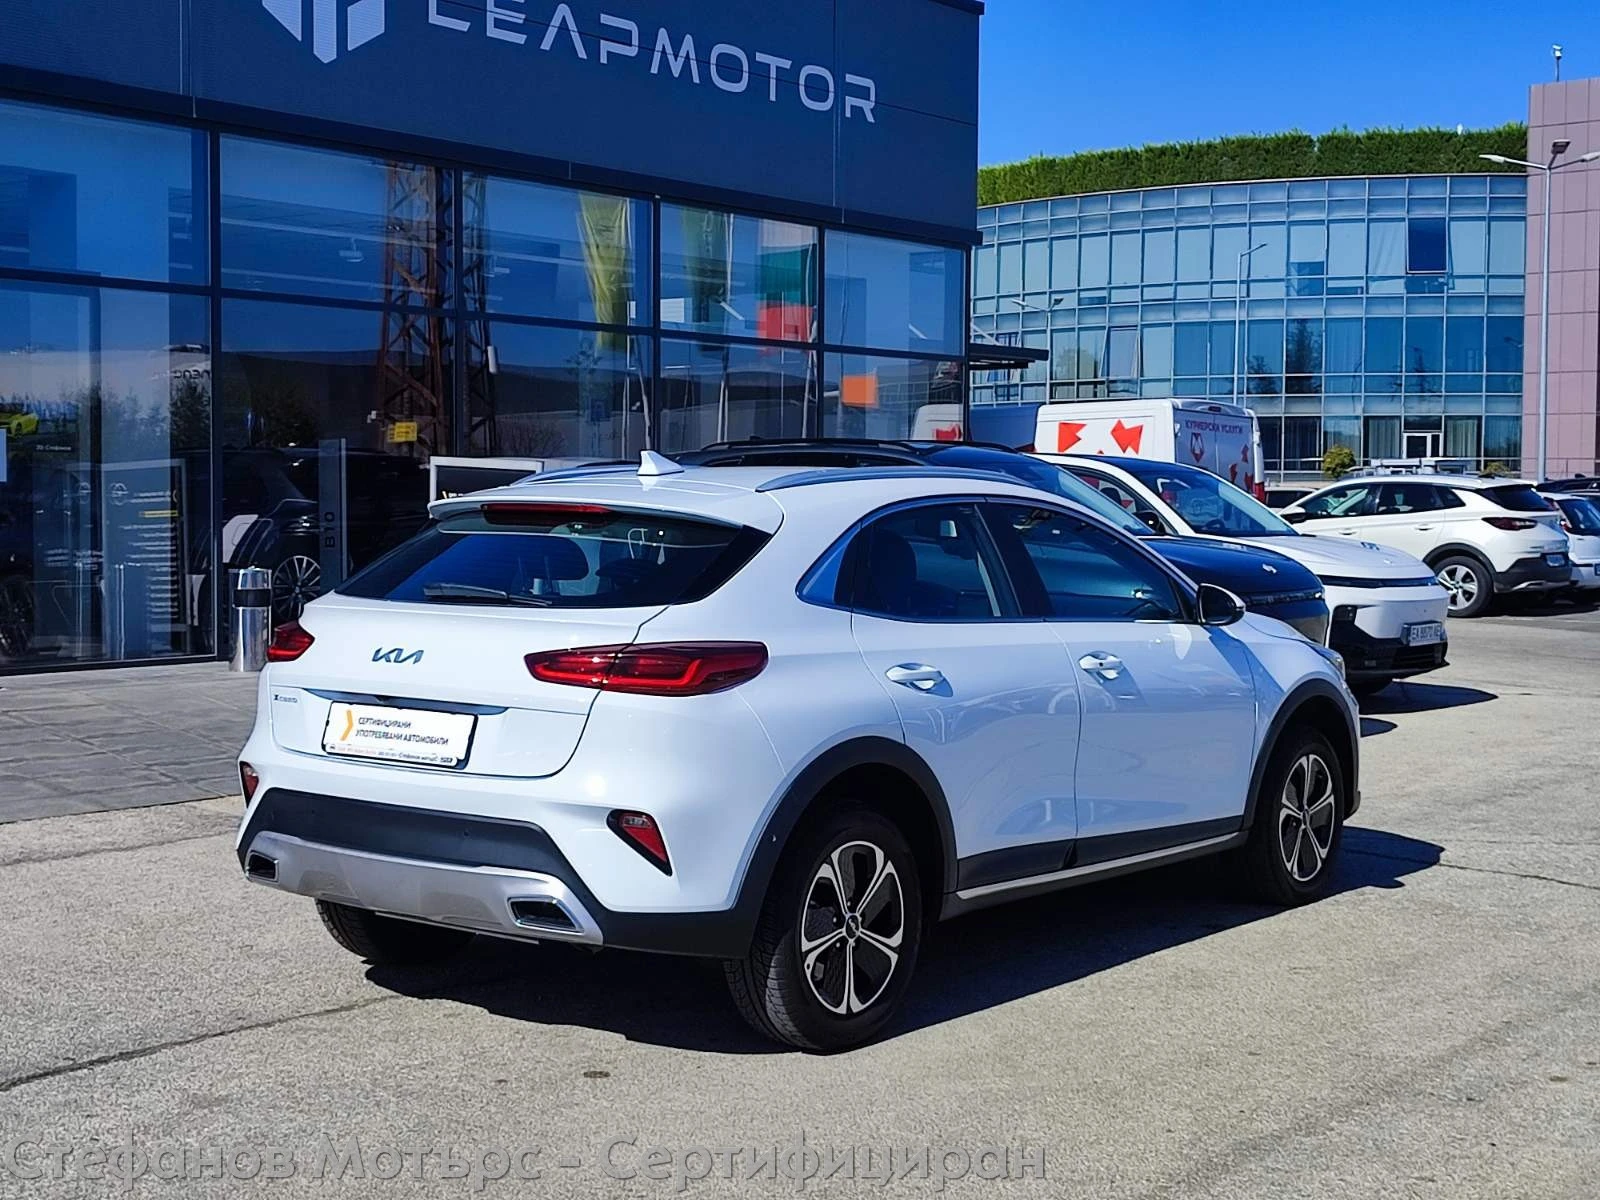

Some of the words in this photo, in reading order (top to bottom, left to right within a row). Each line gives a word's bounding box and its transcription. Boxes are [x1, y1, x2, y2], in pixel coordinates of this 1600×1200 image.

[428, 0, 877, 123] LEAPMOTOR
[324, 511, 336, 548] B10
[371, 647, 424, 665] KIA
[403, 732, 450, 746] АВТОМОБИЛИ
